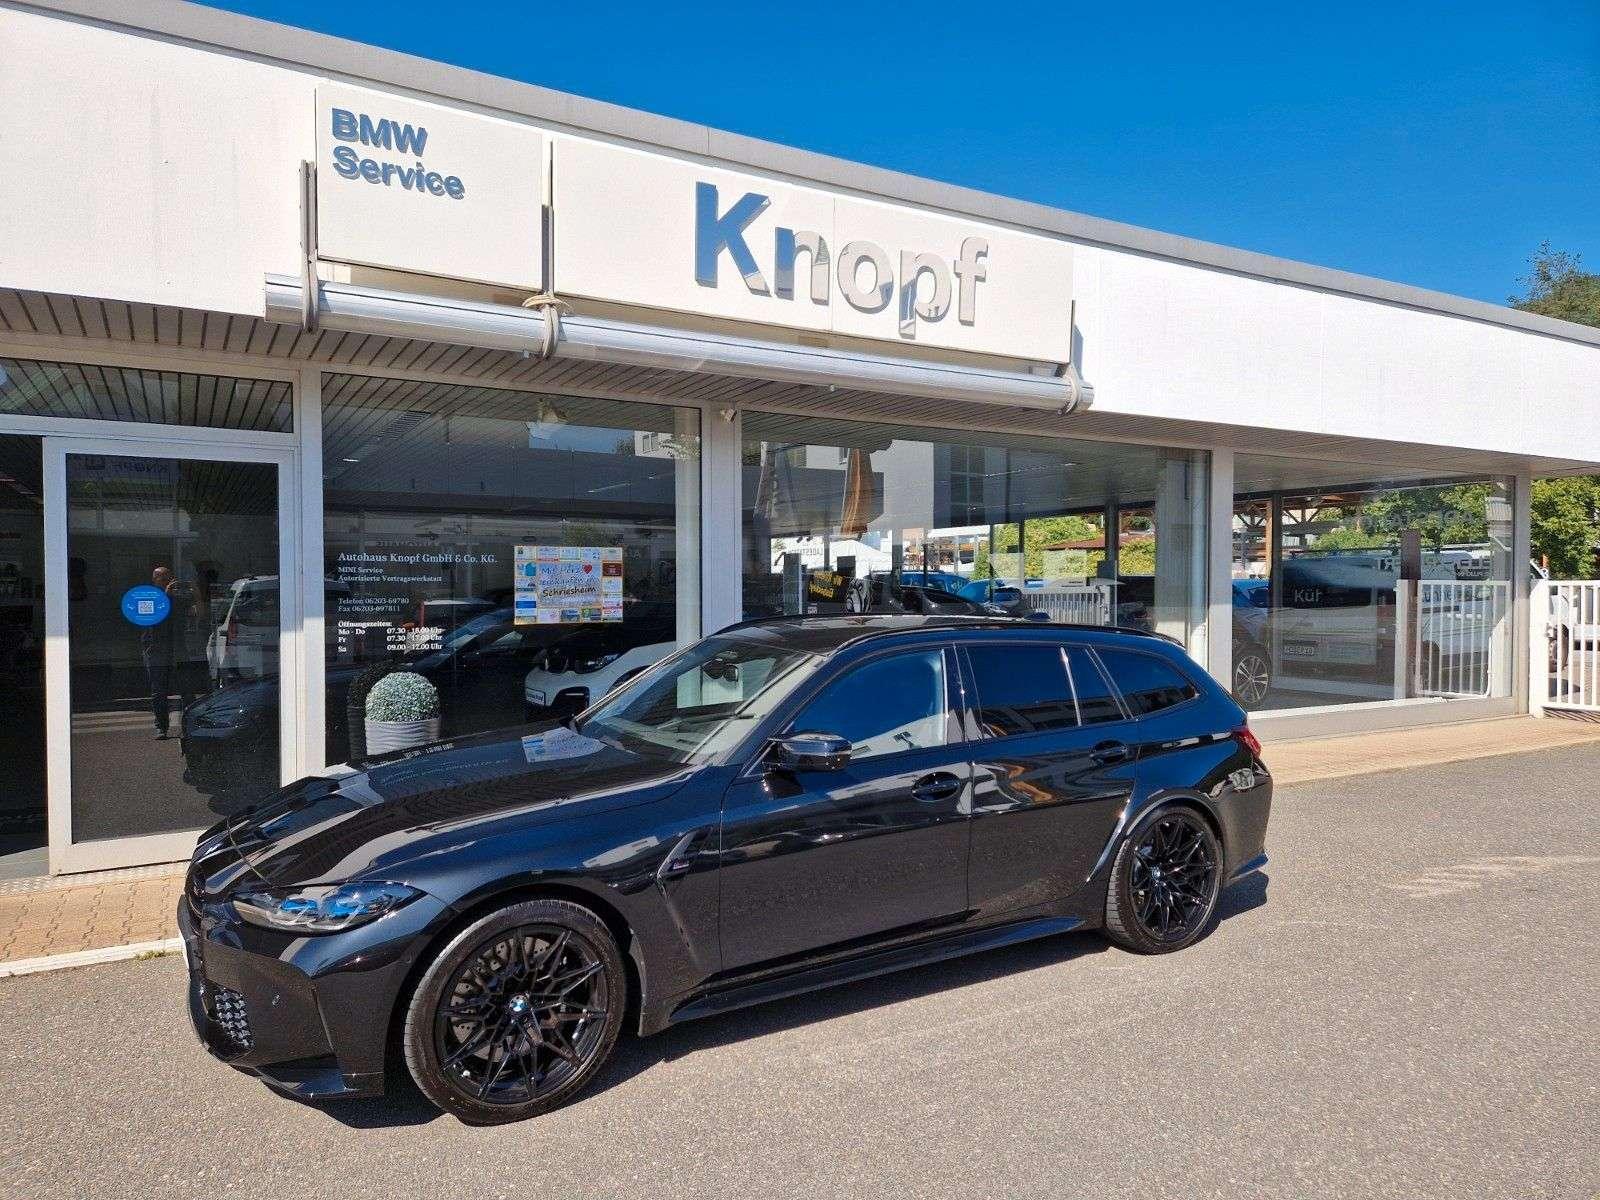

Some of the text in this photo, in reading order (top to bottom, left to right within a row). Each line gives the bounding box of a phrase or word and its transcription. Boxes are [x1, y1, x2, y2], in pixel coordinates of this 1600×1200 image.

[331, 107, 428, 157] BMW
[332, 145, 466, 201] Service
[695, 181, 989, 339] Knopf
[338, 552, 387, 562] Autohaus
[389, 553, 420, 564] Knopf
[421, 553, 453, 563] GmbH
[454, 554, 461, 563] &
[463, 554, 478, 563] Co.
[358, 566, 384, 574] Service
[542, 586, 597, 598] Schriesheim
[338, 628, 350, 636] Mo
[355, 628, 366, 636] Do
[338, 636, 347, 644] Fr
[430, 634, 443, 642] Uhr
[337, 645, 347, 653] Sa
[430, 642, 443, 650] Uhr
